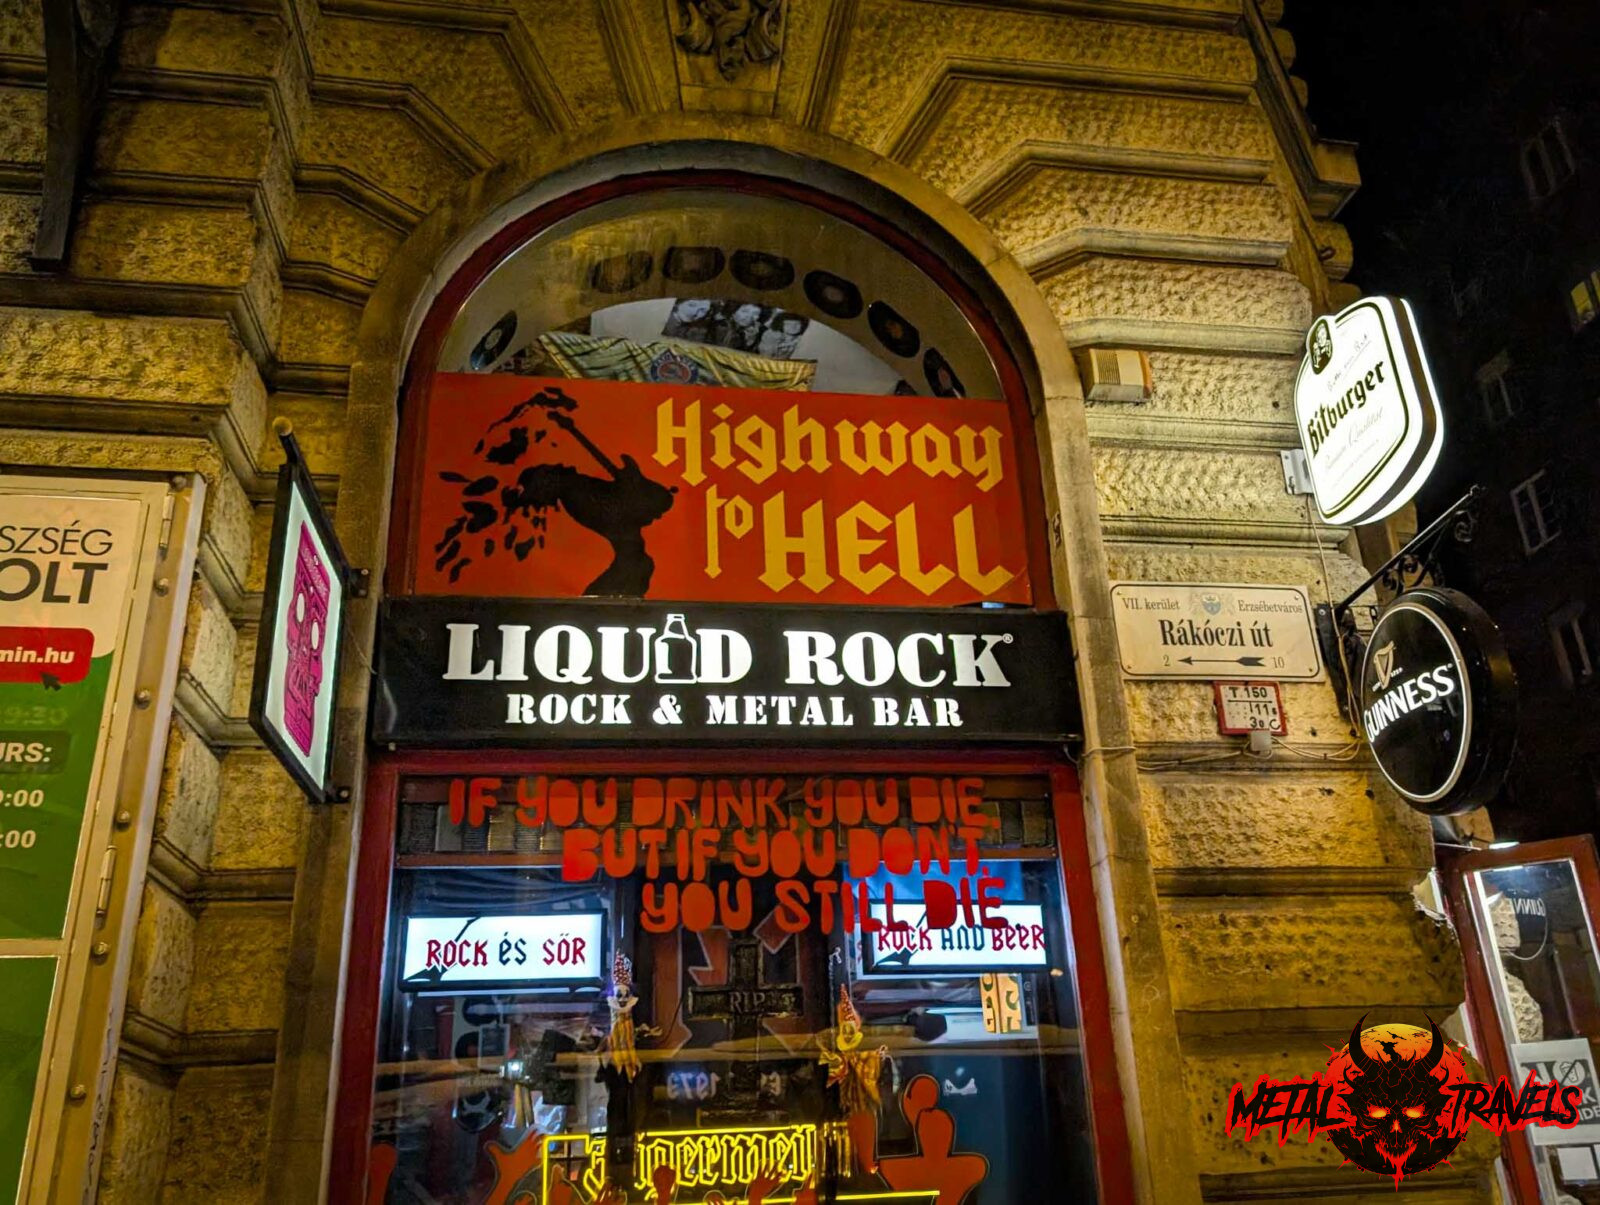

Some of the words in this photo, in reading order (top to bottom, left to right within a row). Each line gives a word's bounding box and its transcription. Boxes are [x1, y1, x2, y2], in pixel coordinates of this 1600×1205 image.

[1307, 361, 1384, 459] Bitburger
[652, 397, 1005, 491] Highway
[703, 485, 755, 579] to
[758, 490, 1015, 596] HELL
[1121, 597, 1142, 611] VII.
[1144, 599, 1180, 611] kerület
[1238, 600, 1303, 614] Erzsébetváros
[1159, 619, 1245, 647] Rákóczi
[1250, 620, 1274, 648] út
[1163, 655, 1170, 667] 2
[1272, 656, 1285, 669] 10
[1228, 686, 1239, 698] T
[1244, 686, 1268, 698] 150
[1364, 665, 1455, 743] GUINNESS
[505, 693, 633, 725] ROCK
[653, 693, 683, 726] &
[707, 695, 854, 727] METAL
[872, 697, 964, 728] BAR
[0, 789, 44, 808] :00
[449, 778, 501, 827] IF
[516, 776, 618, 827] YOU
[631, 778, 798, 831] DRINK,
[804, 778, 899, 827] YOU
[561, 828, 667, 882] BUT
[677, 828, 720, 881] IF
[732, 828, 836, 879] YOU
[640, 877, 752, 933] YOU
[775, 880, 909, 935] STILL
[425, 938, 489, 967] ROCK
[941, 924, 985, 951] AND
